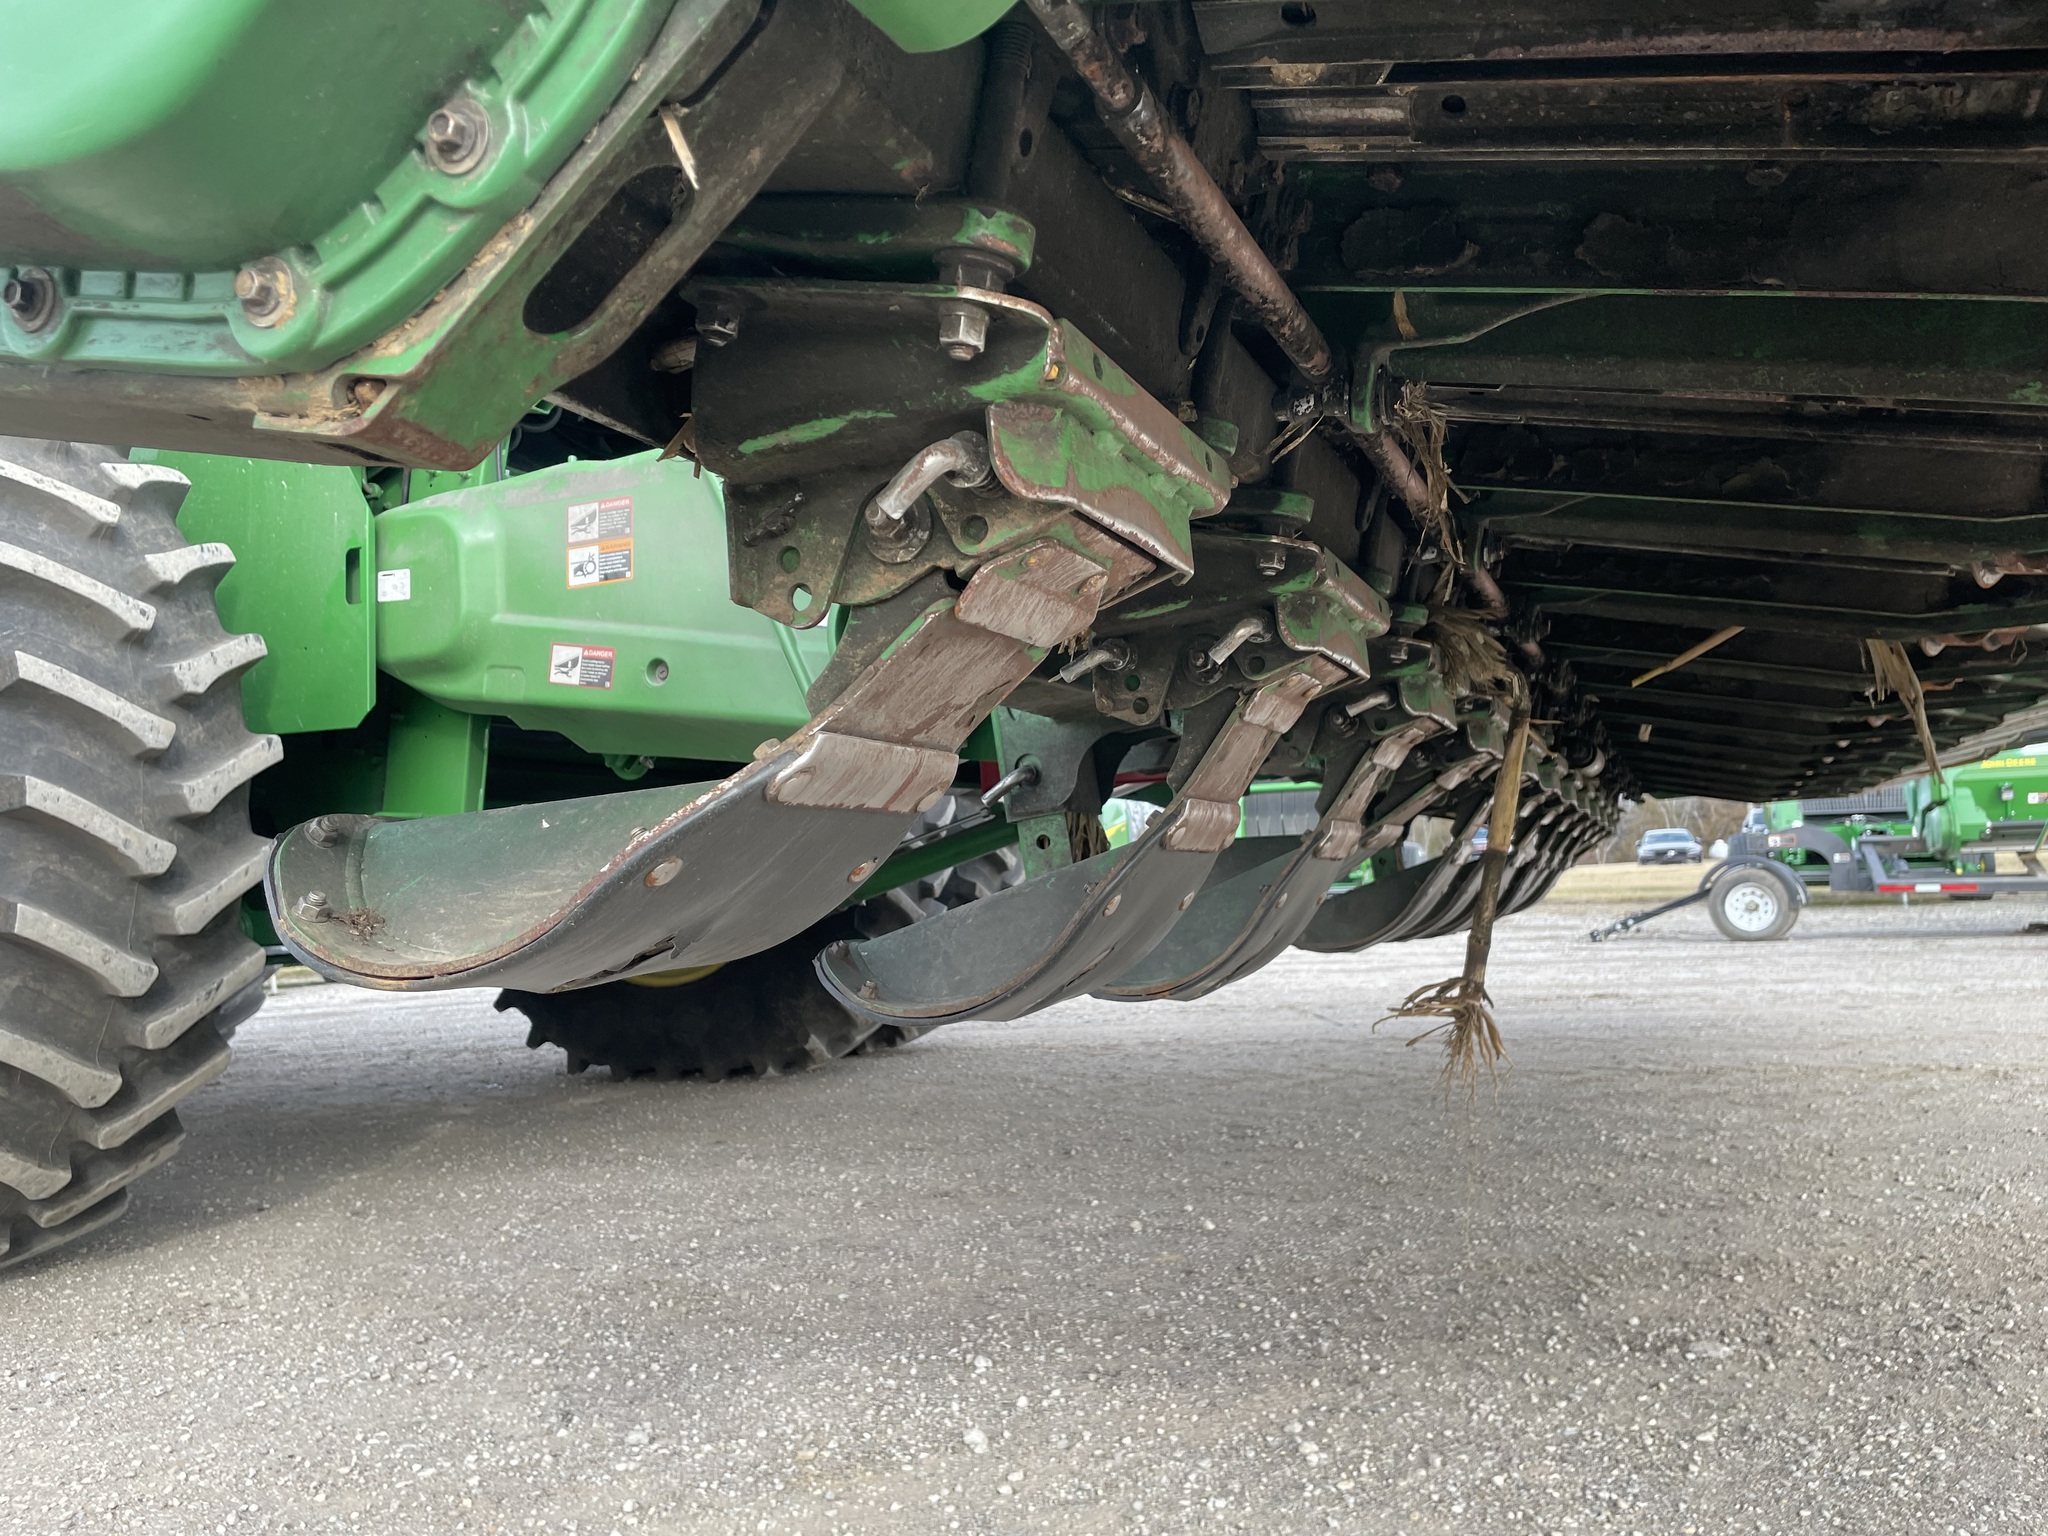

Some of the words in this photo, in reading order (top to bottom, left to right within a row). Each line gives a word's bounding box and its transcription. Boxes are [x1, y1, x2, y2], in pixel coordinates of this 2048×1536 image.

[605, 499, 630, 508] DANGER
[605, 541, 631, 550] WARNING
[588, 649, 613, 658] DANGER
[2006, 758, 2036, 767] DEERE
